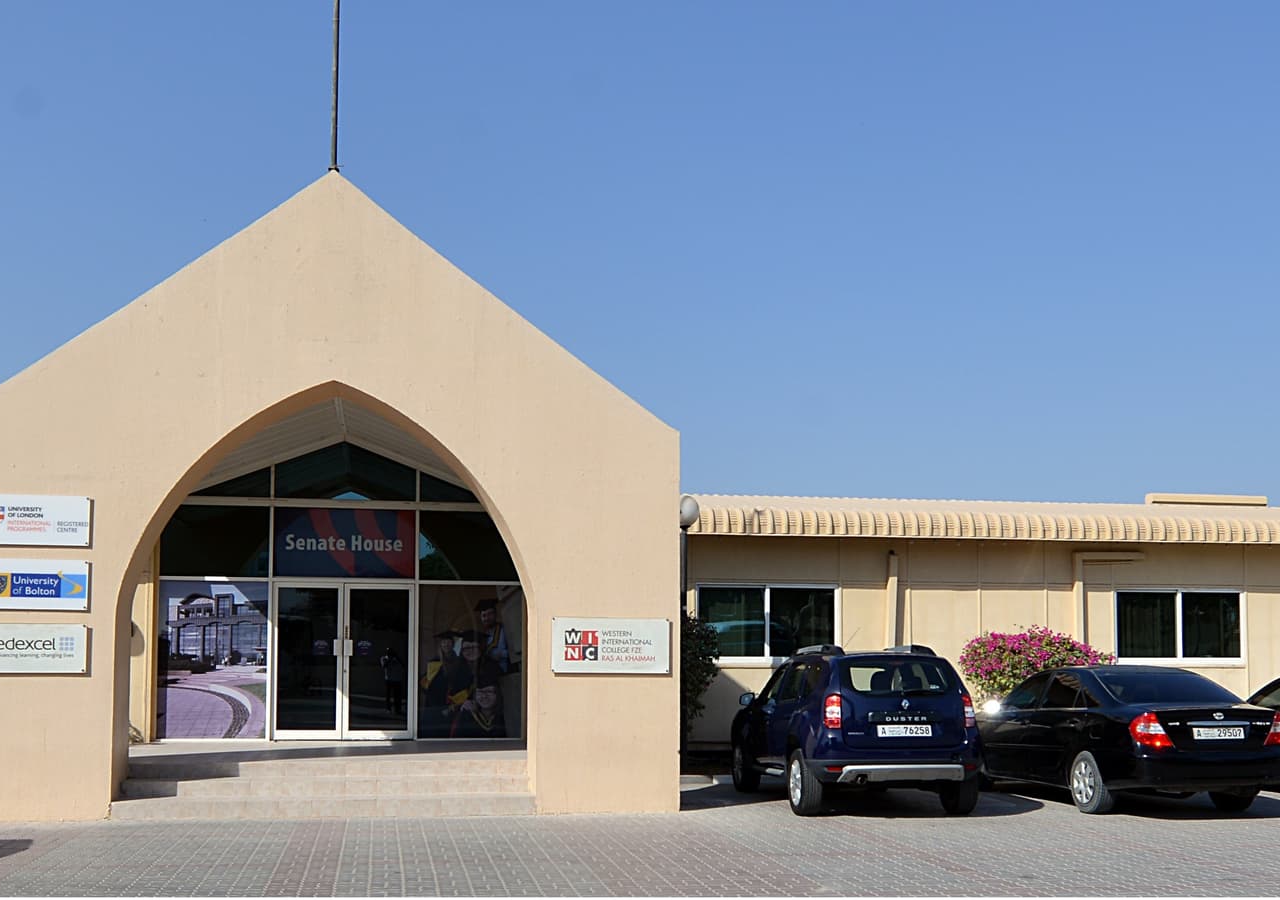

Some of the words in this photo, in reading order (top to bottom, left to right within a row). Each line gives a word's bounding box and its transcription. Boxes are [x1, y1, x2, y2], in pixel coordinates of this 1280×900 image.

[285, 534, 346, 551] Senate
[351, 534, 403, 552] House
[13, 575, 59, 587] University
[12, 587, 23, 595] of
[25, 586, 56, 596] Bolton
[881, 727, 887, 735] A
[904, 726, 930, 735] 76258
[1196, 729, 1202, 737] A
[1217, 728, 1242, 737] 29507
